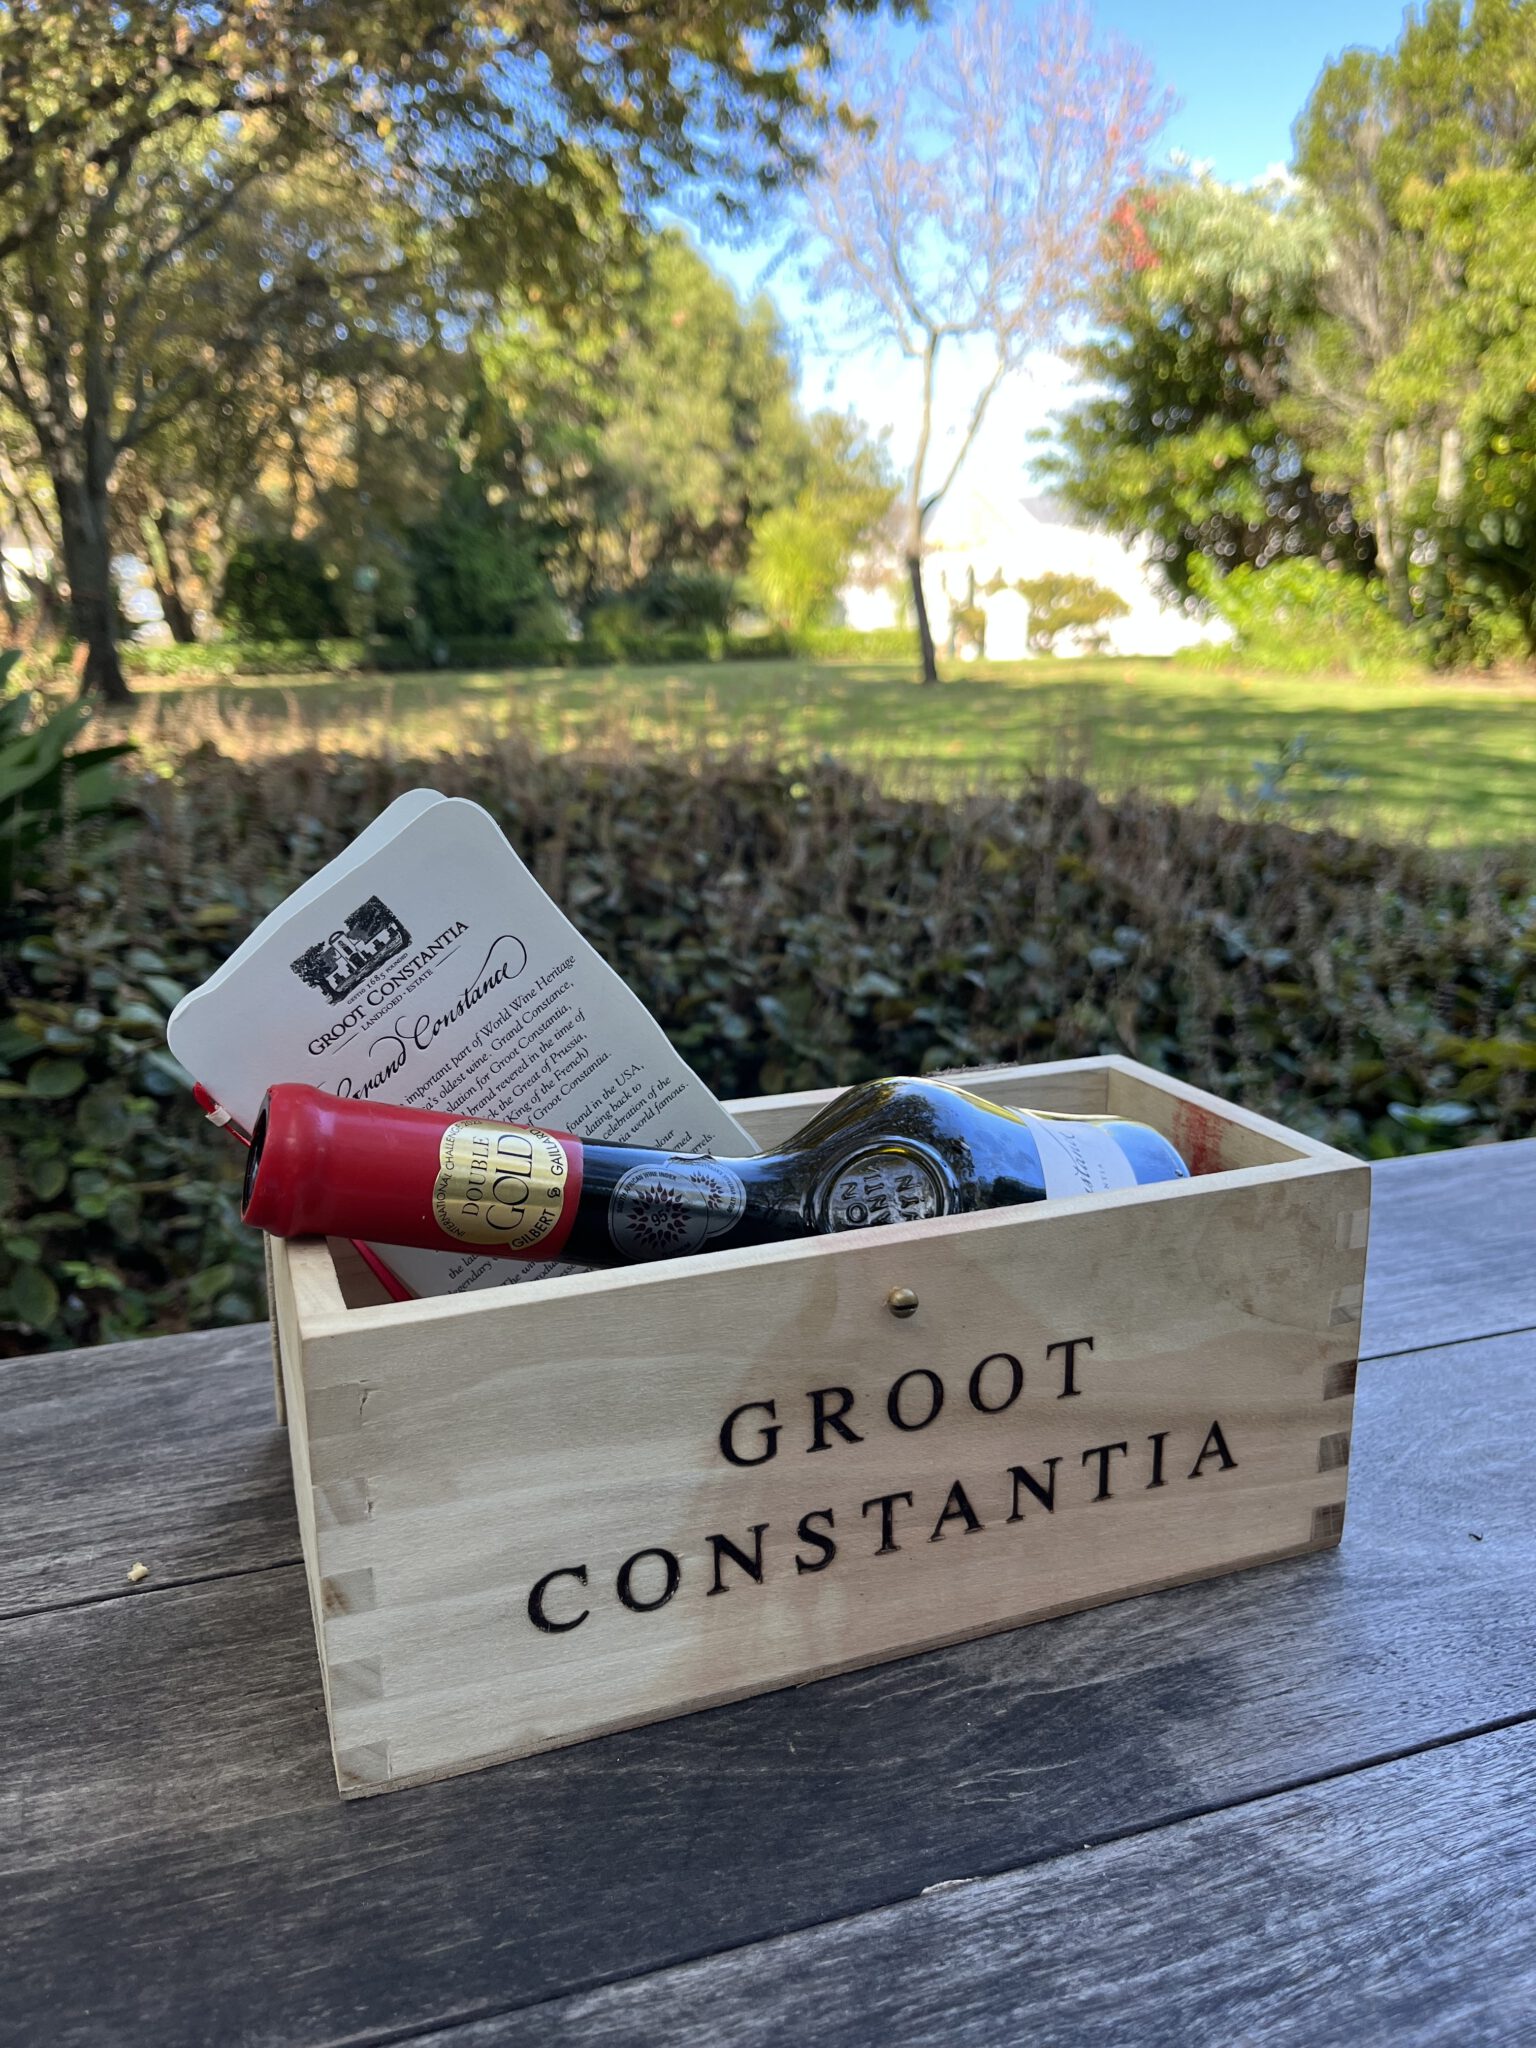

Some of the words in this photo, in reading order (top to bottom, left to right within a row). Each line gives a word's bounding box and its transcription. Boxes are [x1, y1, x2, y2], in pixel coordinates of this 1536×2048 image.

[307, 1004, 367, 1055] GROOT
[366, 921, 469, 1006] CONSTANTIA
[360, 994, 403, 1031] LANDGOED
[405, 968, 434, 993] ESTATE
[366, 973, 386, 989] 1685
[395, 935, 526, 1050] Constance
[404, 1063, 452, 1104] important
[450, 1045, 472, 1068] part
[471, 1031, 483, 1048] of
[479, 1007, 512, 1037] World
[508, 988, 537, 1011] Wine
[533, 955, 576, 991] Heritage
[439, 1072, 466, 1099] oldest
[465, 1053, 492, 1075] wine.
[490, 1019, 524, 1051] Grand
[521, 981, 574, 1024] Constance,
[465, 1087, 497, 1116] brand
[495, 1057, 529, 1092] revered
[527, 1052, 540, 1063] in
[538, 1038, 554, 1054] the
[553, 1020, 575, 1040] time
[574, 1007, 586, 1023] of
[475, 1072, 490, 1091] for
[489, 1047, 520, 1074] Groot
[517, 1004, 572, 1049] Constantia,
[498, 1096, 514, 1111] the
[511, 1071, 541, 1097] Great
[540, 1057, 552, 1074] of
[548, 1033, 587, 1064] Prussia,
[530, 1088, 541, 1104] of
[540, 1079, 555, 1095] the
[552, 1047, 589, 1082] French)
[532, 1094, 562, 1120] Groot
[559, 1052, 612, 1096] Constantia.
[565, 1104, 593, 1134] found
[590, 1099, 603, 1110] in
[601, 1085, 617, 1100] the
[614, 1064, 645, 1086] USA,
[584, 1109, 613, 1136] dating
[608, 1090, 633, 1112] back
[631, 1083, 642, 1094] to
[603, 1098, 648, 1140] celebration
[647, 1084, 658, 1100] of
[656, 1076, 671, 1091] the
[630, 1106, 655, 1133] world
[654, 1083, 689, 1115] famous.
[445, 1123, 464, 1170] CHALLENGE
[462, 1136, 489, 1216] DOUBLE
[530, 1129, 564, 1176] GAILLARD
[658, 1171, 677, 1181] INDEX
[436, 1174, 465, 1237] INTERNATIONAL
[486, 1134, 533, 1231] GOLD
[511, 1208, 556, 1248] GILBERT
[651, 1209, 668, 1227] 95
[448, 1265, 464, 1279] the
[719, 1336, 1095, 1468] GROOT
[527, 1420, 1238, 1634] CONSTANTIA
